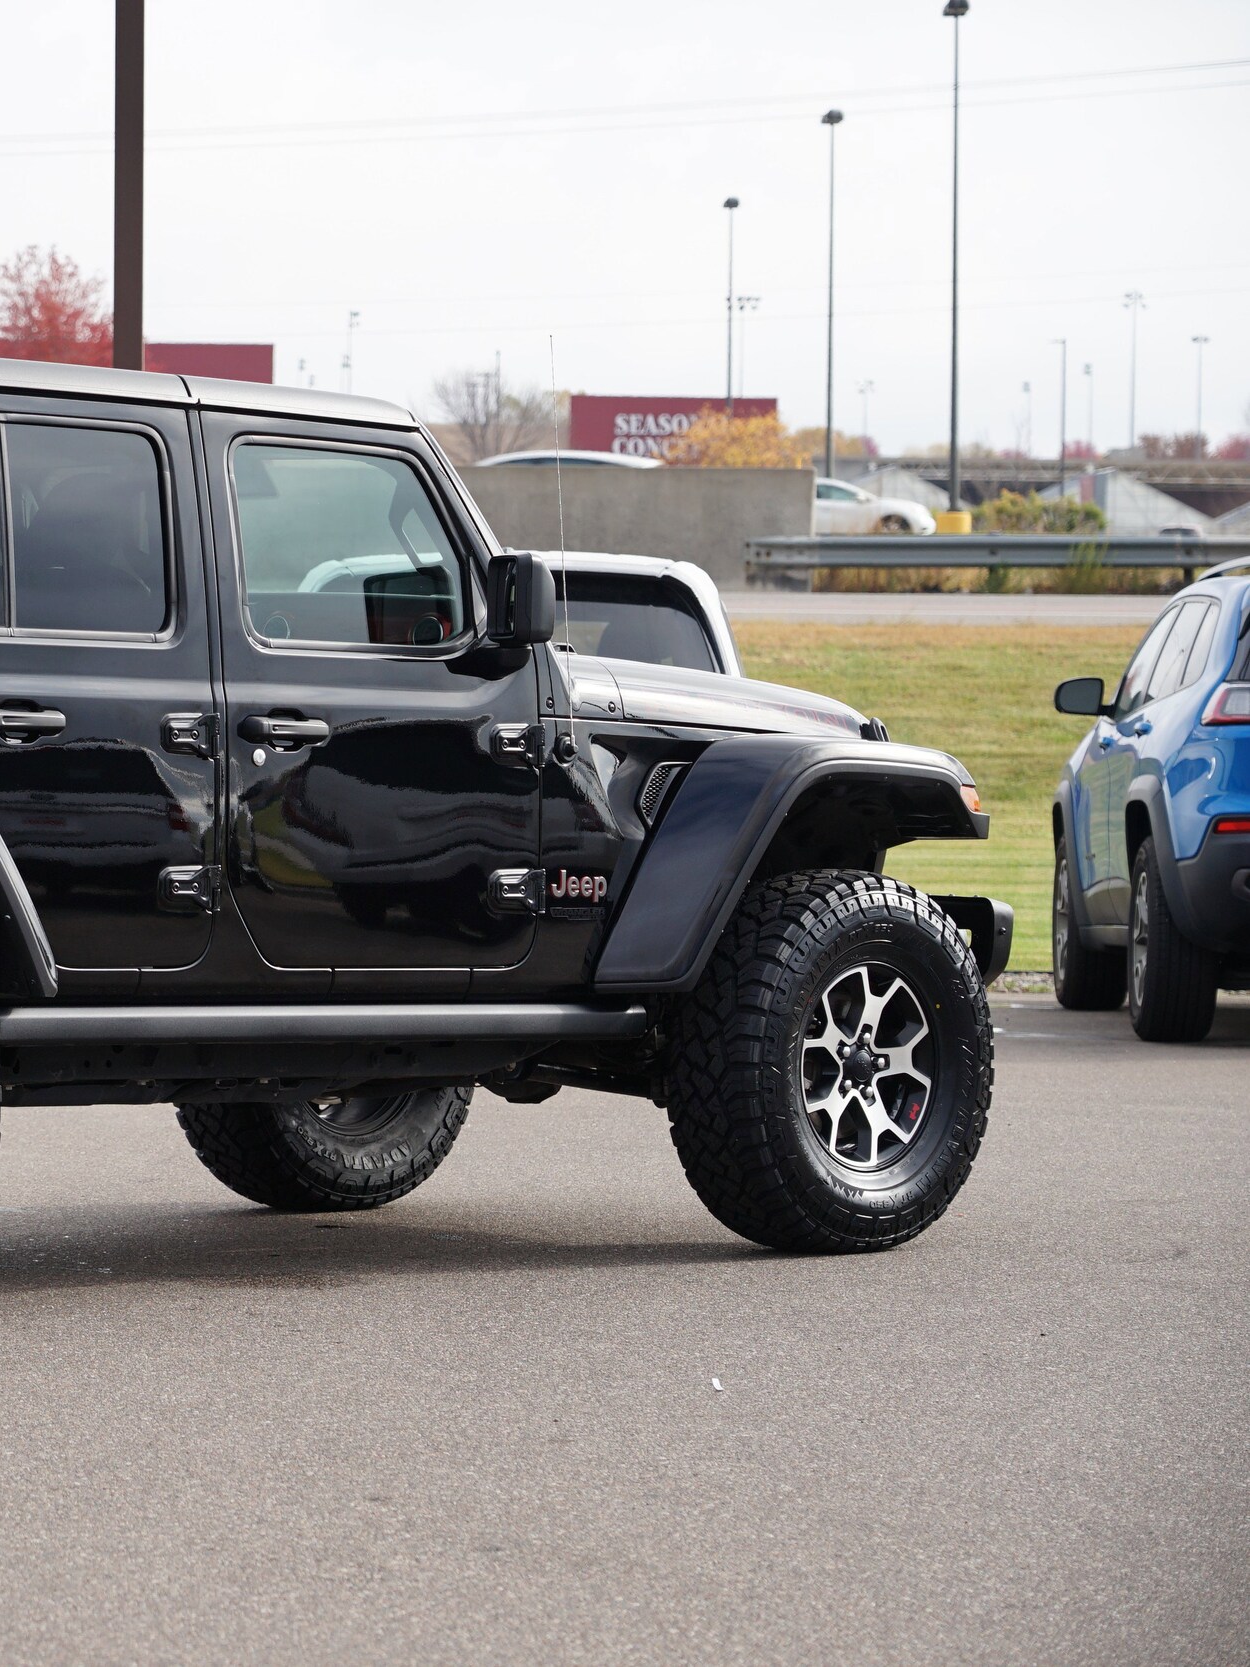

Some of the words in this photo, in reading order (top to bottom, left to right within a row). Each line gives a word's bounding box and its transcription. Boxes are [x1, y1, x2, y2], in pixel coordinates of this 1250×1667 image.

[614, 413, 698, 436] SEASO
[550, 869, 608, 903] Jeep
[342, 1140, 410, 1170] ADVANTA
